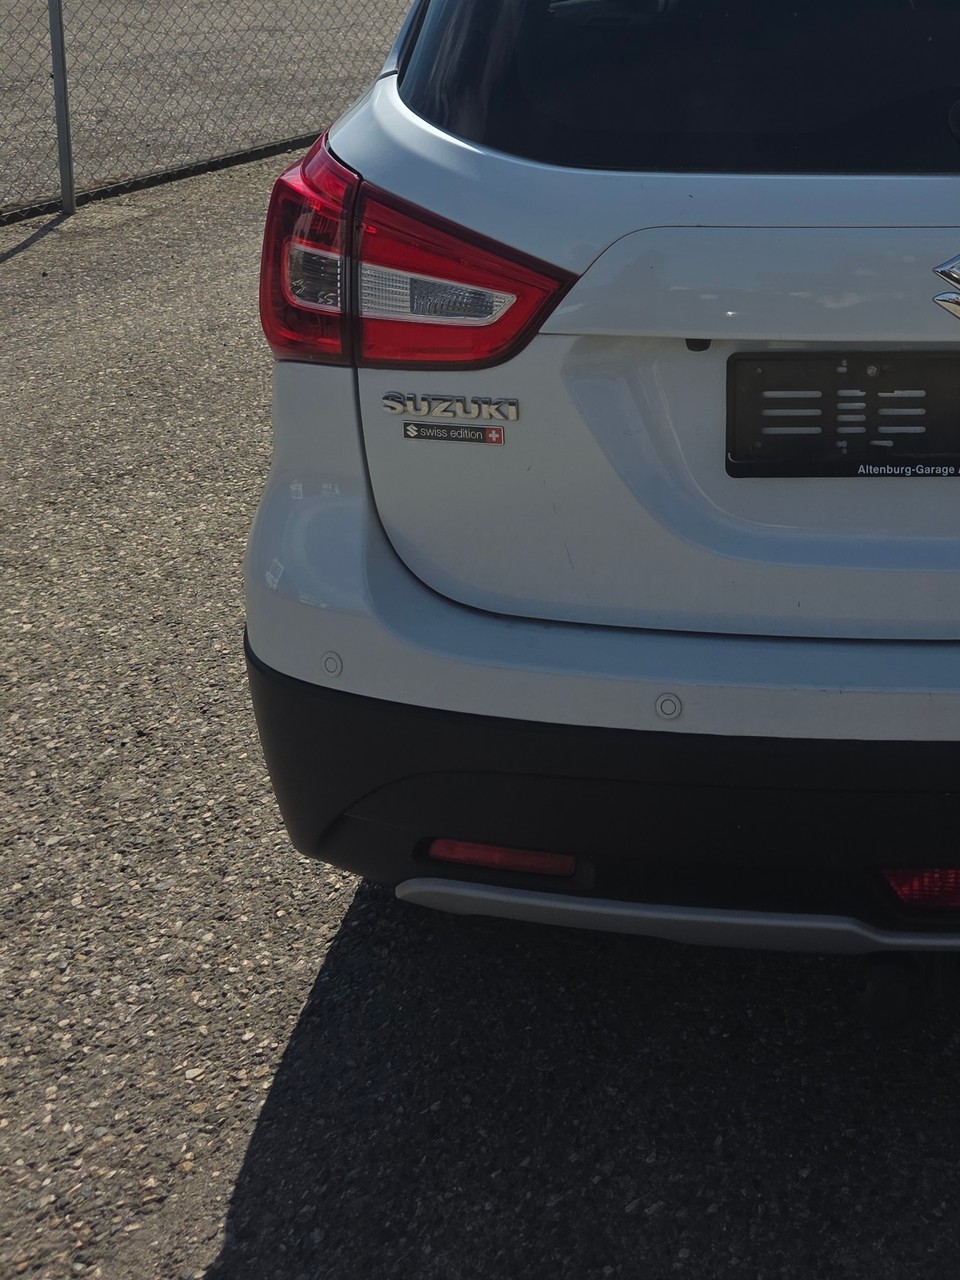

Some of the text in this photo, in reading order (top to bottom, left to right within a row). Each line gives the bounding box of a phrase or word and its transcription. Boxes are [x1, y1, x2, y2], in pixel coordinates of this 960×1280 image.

[382, 391, 520, 421] SUZUKI
[420, 426, 483, 440] swiss edition
[857, 464, 955, 476] Altenburg-Garage
